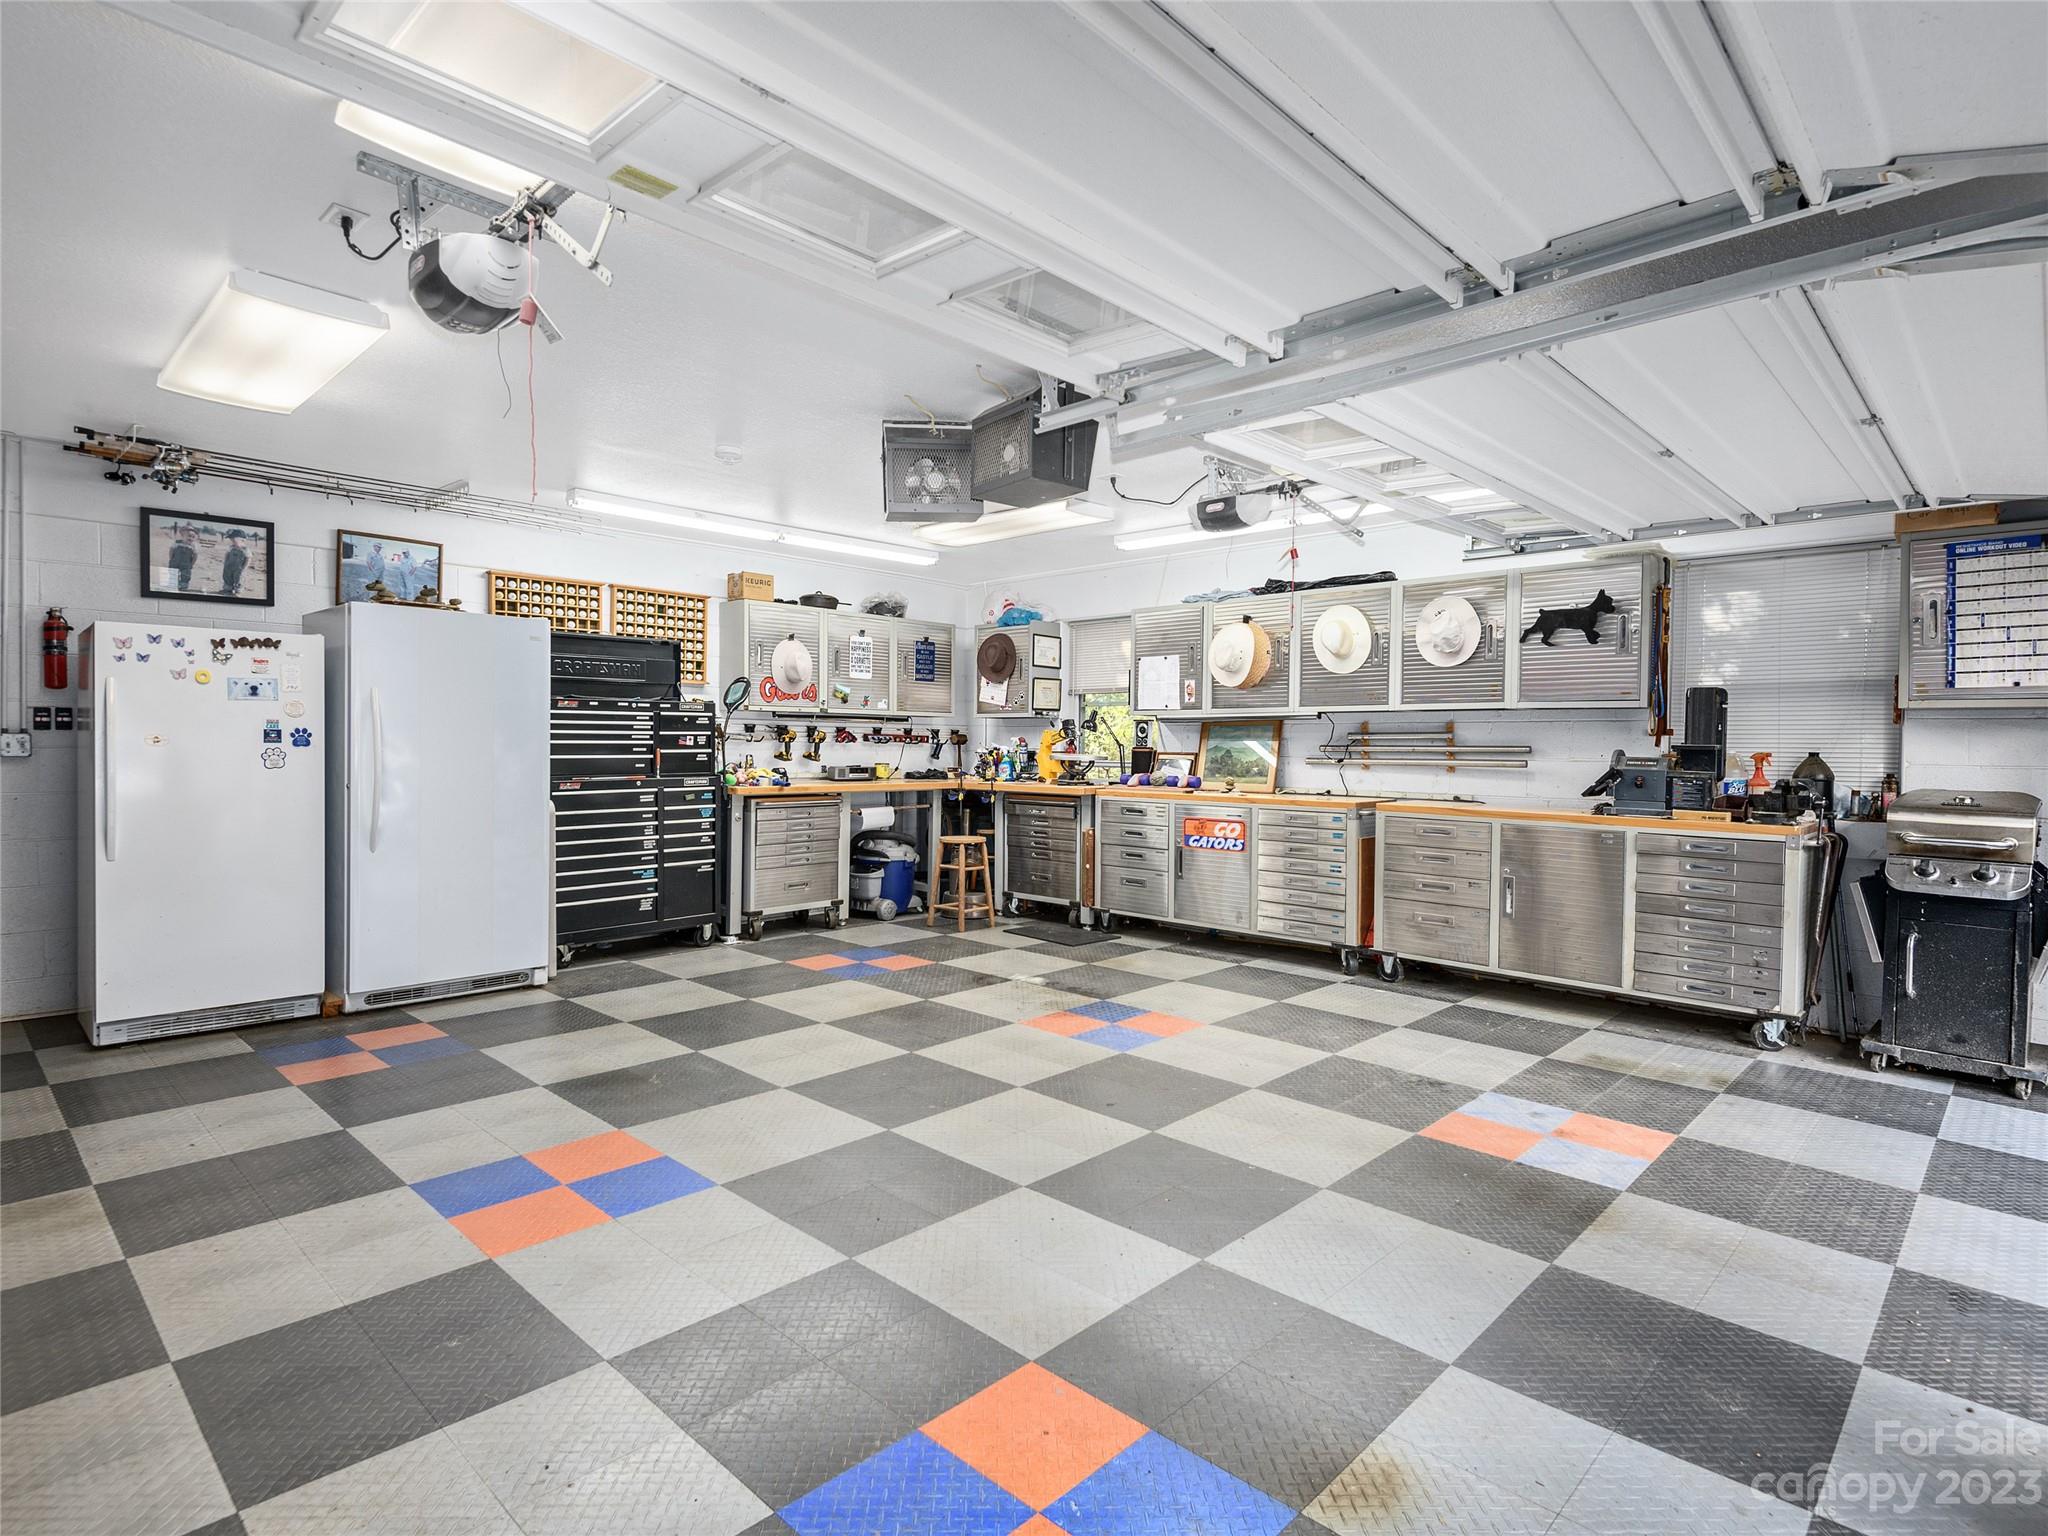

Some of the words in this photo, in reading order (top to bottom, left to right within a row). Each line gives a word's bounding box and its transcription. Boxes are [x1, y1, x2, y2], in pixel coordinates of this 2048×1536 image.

[1955, 546, 1977, 554] ONLINE
[1977, 543, 2007, 552] WORKOUT
[2008, 541, 2028, 549] VIDEO
[745, 577, 772, 587] KEURIG
[1214, 822, 1242, 837] GO
[1188, 835, 1245, 851] GATORS
